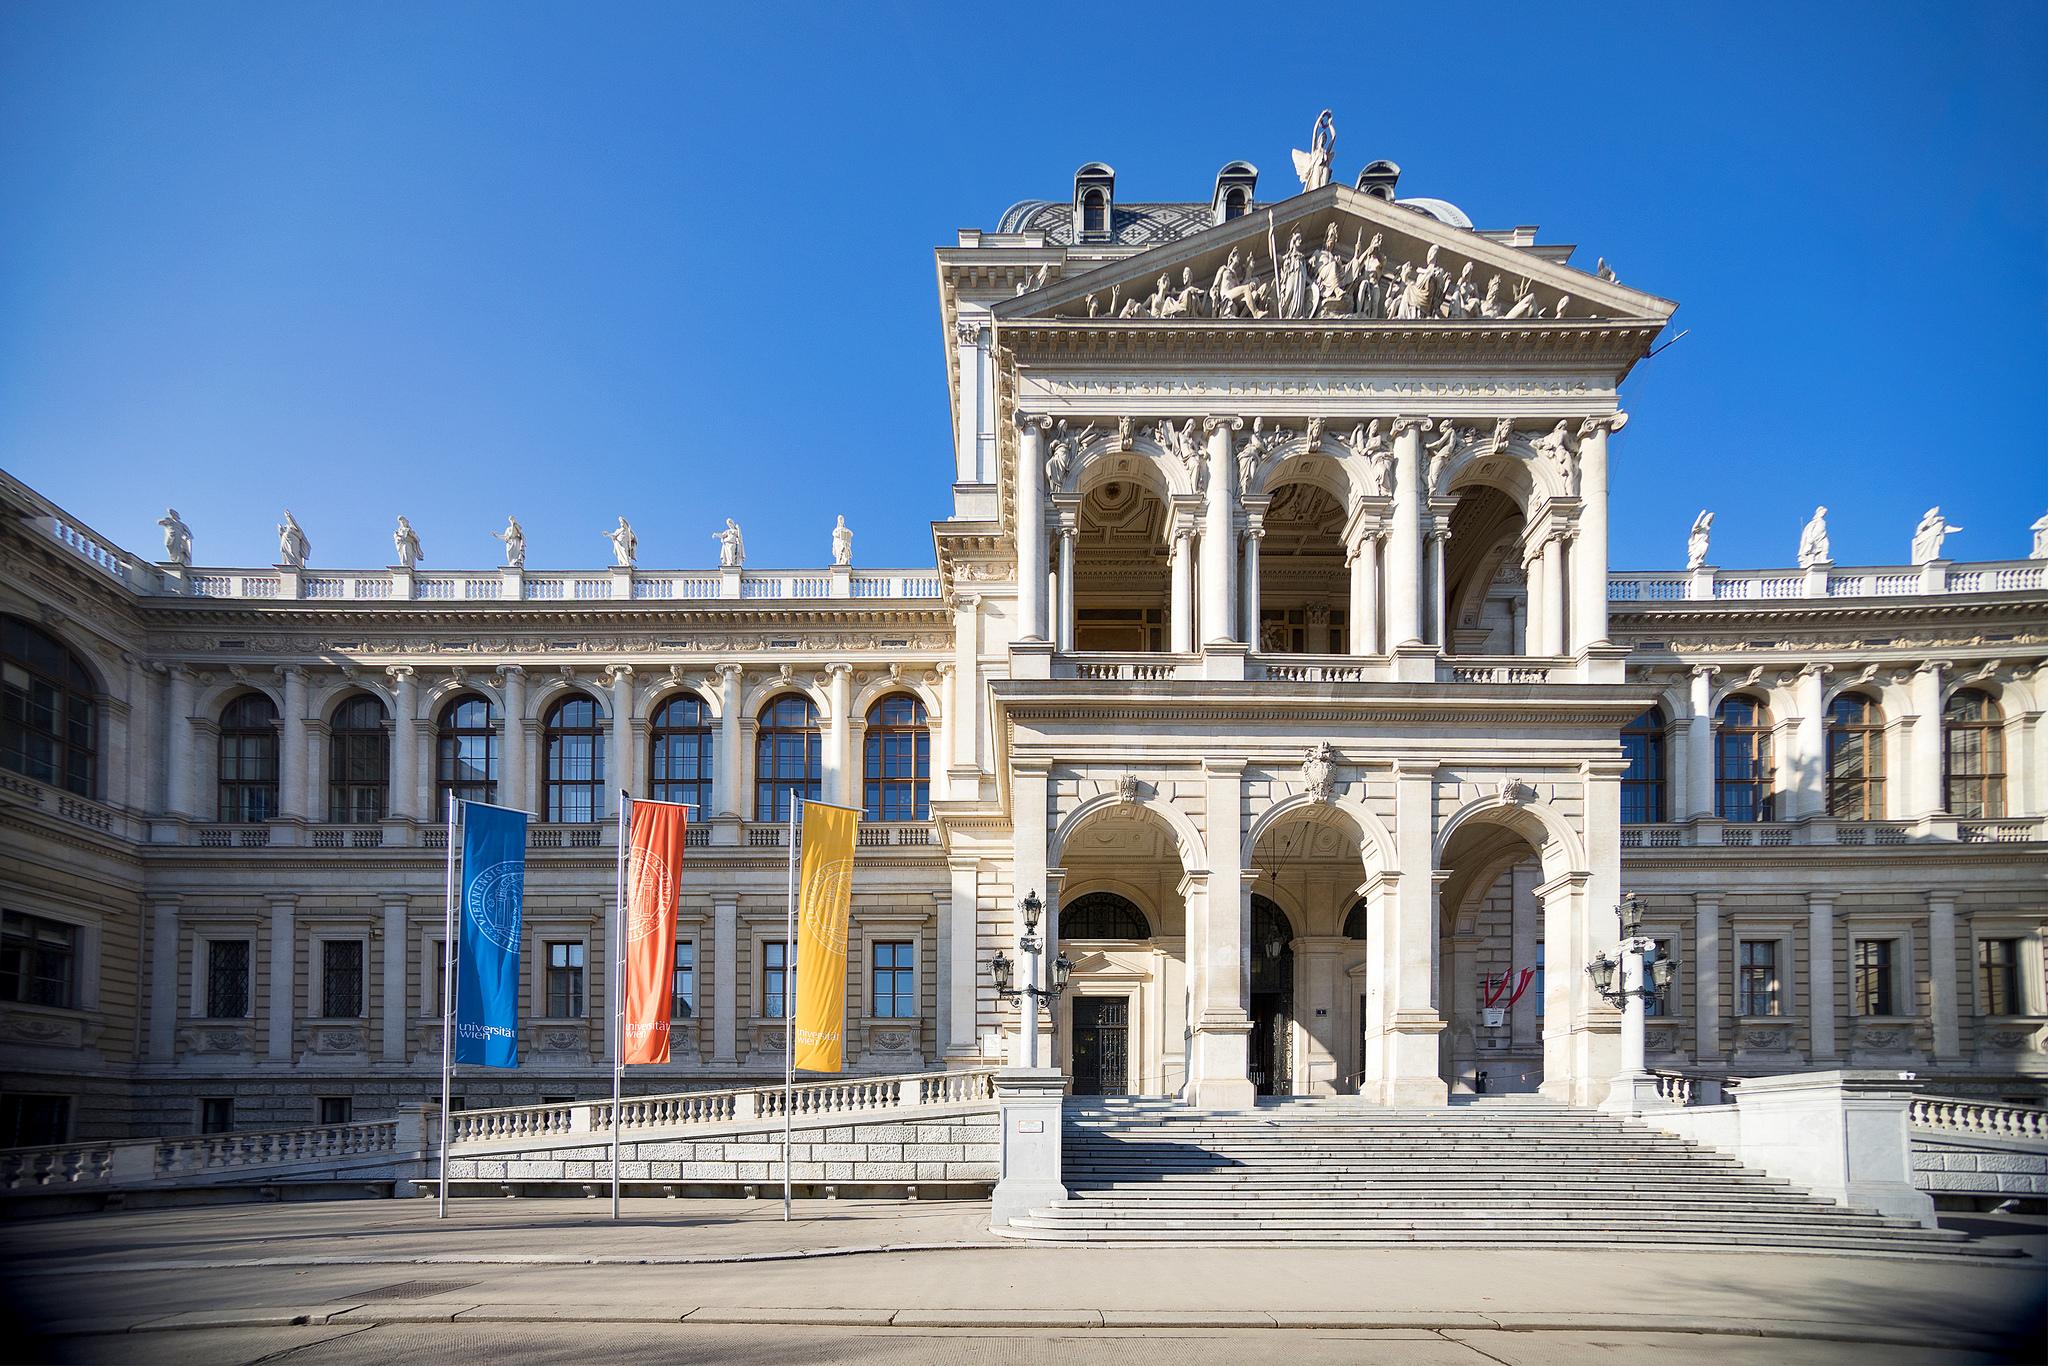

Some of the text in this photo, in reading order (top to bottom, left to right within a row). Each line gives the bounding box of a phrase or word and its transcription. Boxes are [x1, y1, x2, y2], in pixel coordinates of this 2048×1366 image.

[471, 866, 503, 926] VIENNENSIS
[459, 1021, 515, 1038] universität
[460, 1030, 491, 1041] wien
